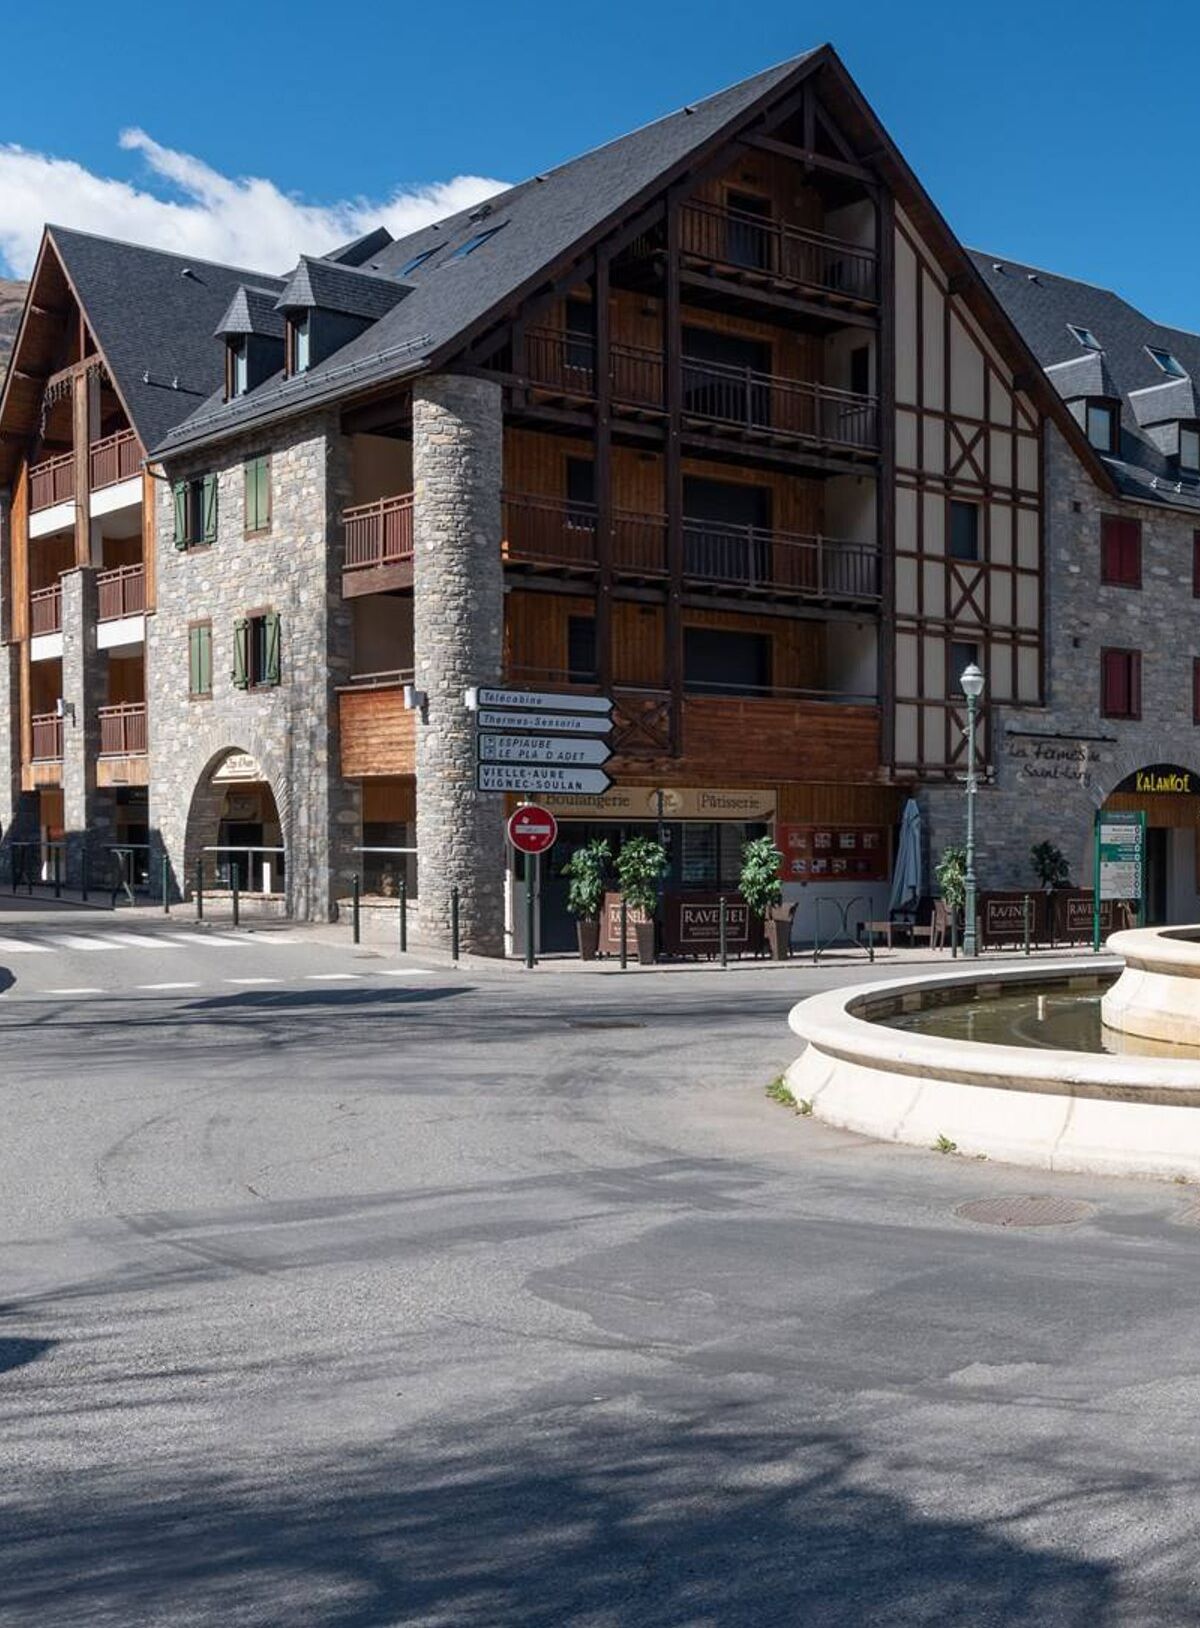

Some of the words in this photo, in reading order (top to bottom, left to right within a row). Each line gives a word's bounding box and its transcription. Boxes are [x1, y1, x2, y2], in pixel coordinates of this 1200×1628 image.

[484, 692, 542, 705] Télécabine
[484, 714, 581, 728] Thermes-Sensoria
[499, 738, 553, 749] ESPIAUBE
[499, 749, 512, 758] LE
[484, 768, 565, 779] VIELLE-AURE
[484, 779, 583, 790] VIGNEC-SOULAN
[702, 791, 761, 809] Pâtisserie
